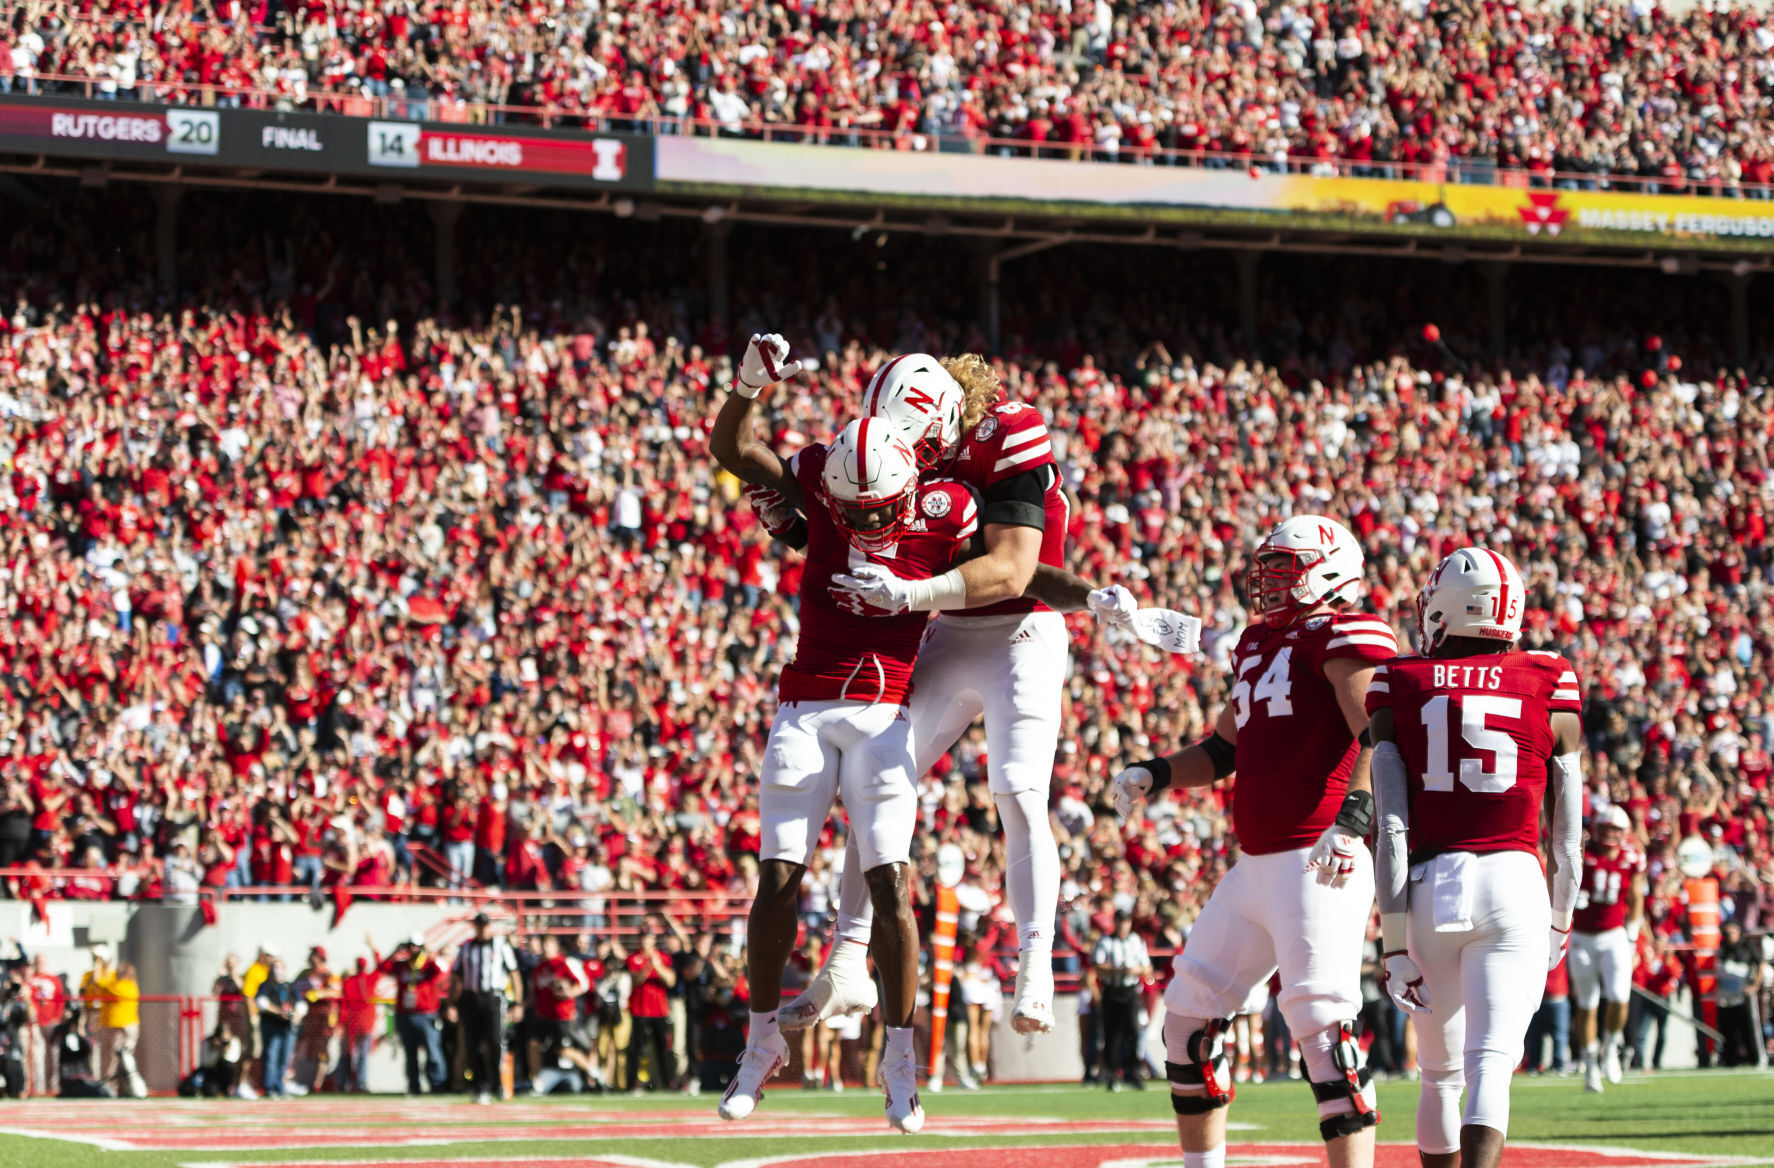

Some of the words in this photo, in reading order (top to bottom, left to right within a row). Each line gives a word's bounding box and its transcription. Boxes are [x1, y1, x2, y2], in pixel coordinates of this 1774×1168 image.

[51, 112, 162, 143] RUTGERS
[179, 120, 213, 145] 20
[262, 125, 323, 151] FINAL
[379, 132, 404, 155] 14
[427, 137, 523, 166] ILLINOIS
[1578, 207, 1668, 232] MASSEY
[904, 386, 935, 415] N
[1317, 524, 1335, 546] N
[1173, 621, 1188, 649] MOM
[1231, 645, 1294, 732] 54
[1433, 664, 1503, 690] BETTS
[1420, 694, 1523, 794] 15
